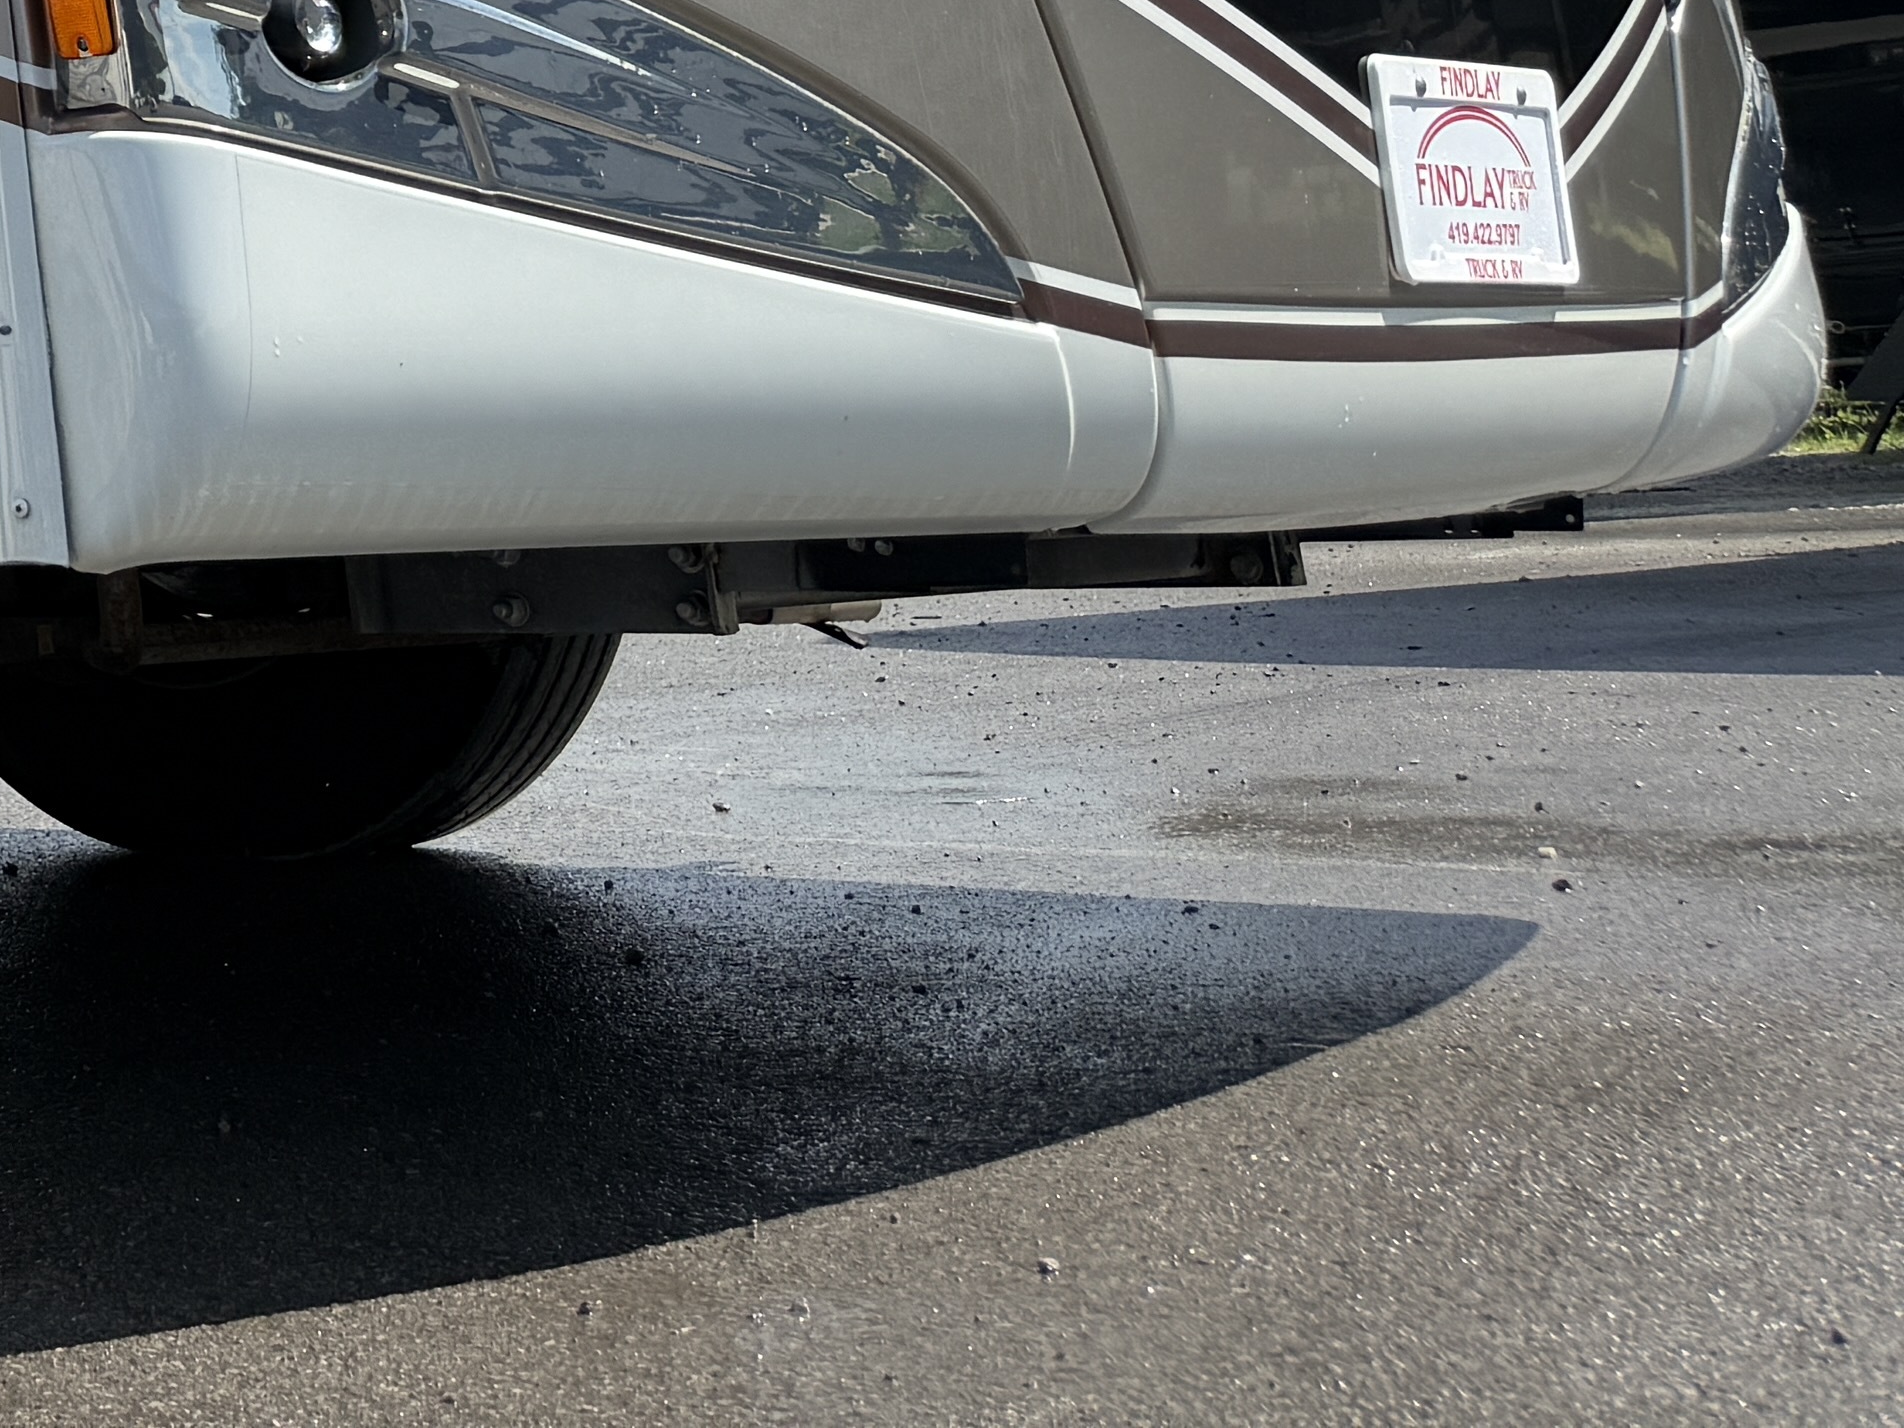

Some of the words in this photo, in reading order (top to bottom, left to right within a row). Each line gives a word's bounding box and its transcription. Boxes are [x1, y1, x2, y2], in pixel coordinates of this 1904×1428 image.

[1439, 66, 1501, 101] FINDLAY
[1415, 163, 1505, 209] FINDLAY
[1507, 169, 1537, 190] TRUCK
[1518, 192, 1529, 212] RV
[1448, 222, 1521, 246] 419.422.9797
[1465, 258, 1500, 278] TRUCK
[1510, 259, 1523, 279] RV
